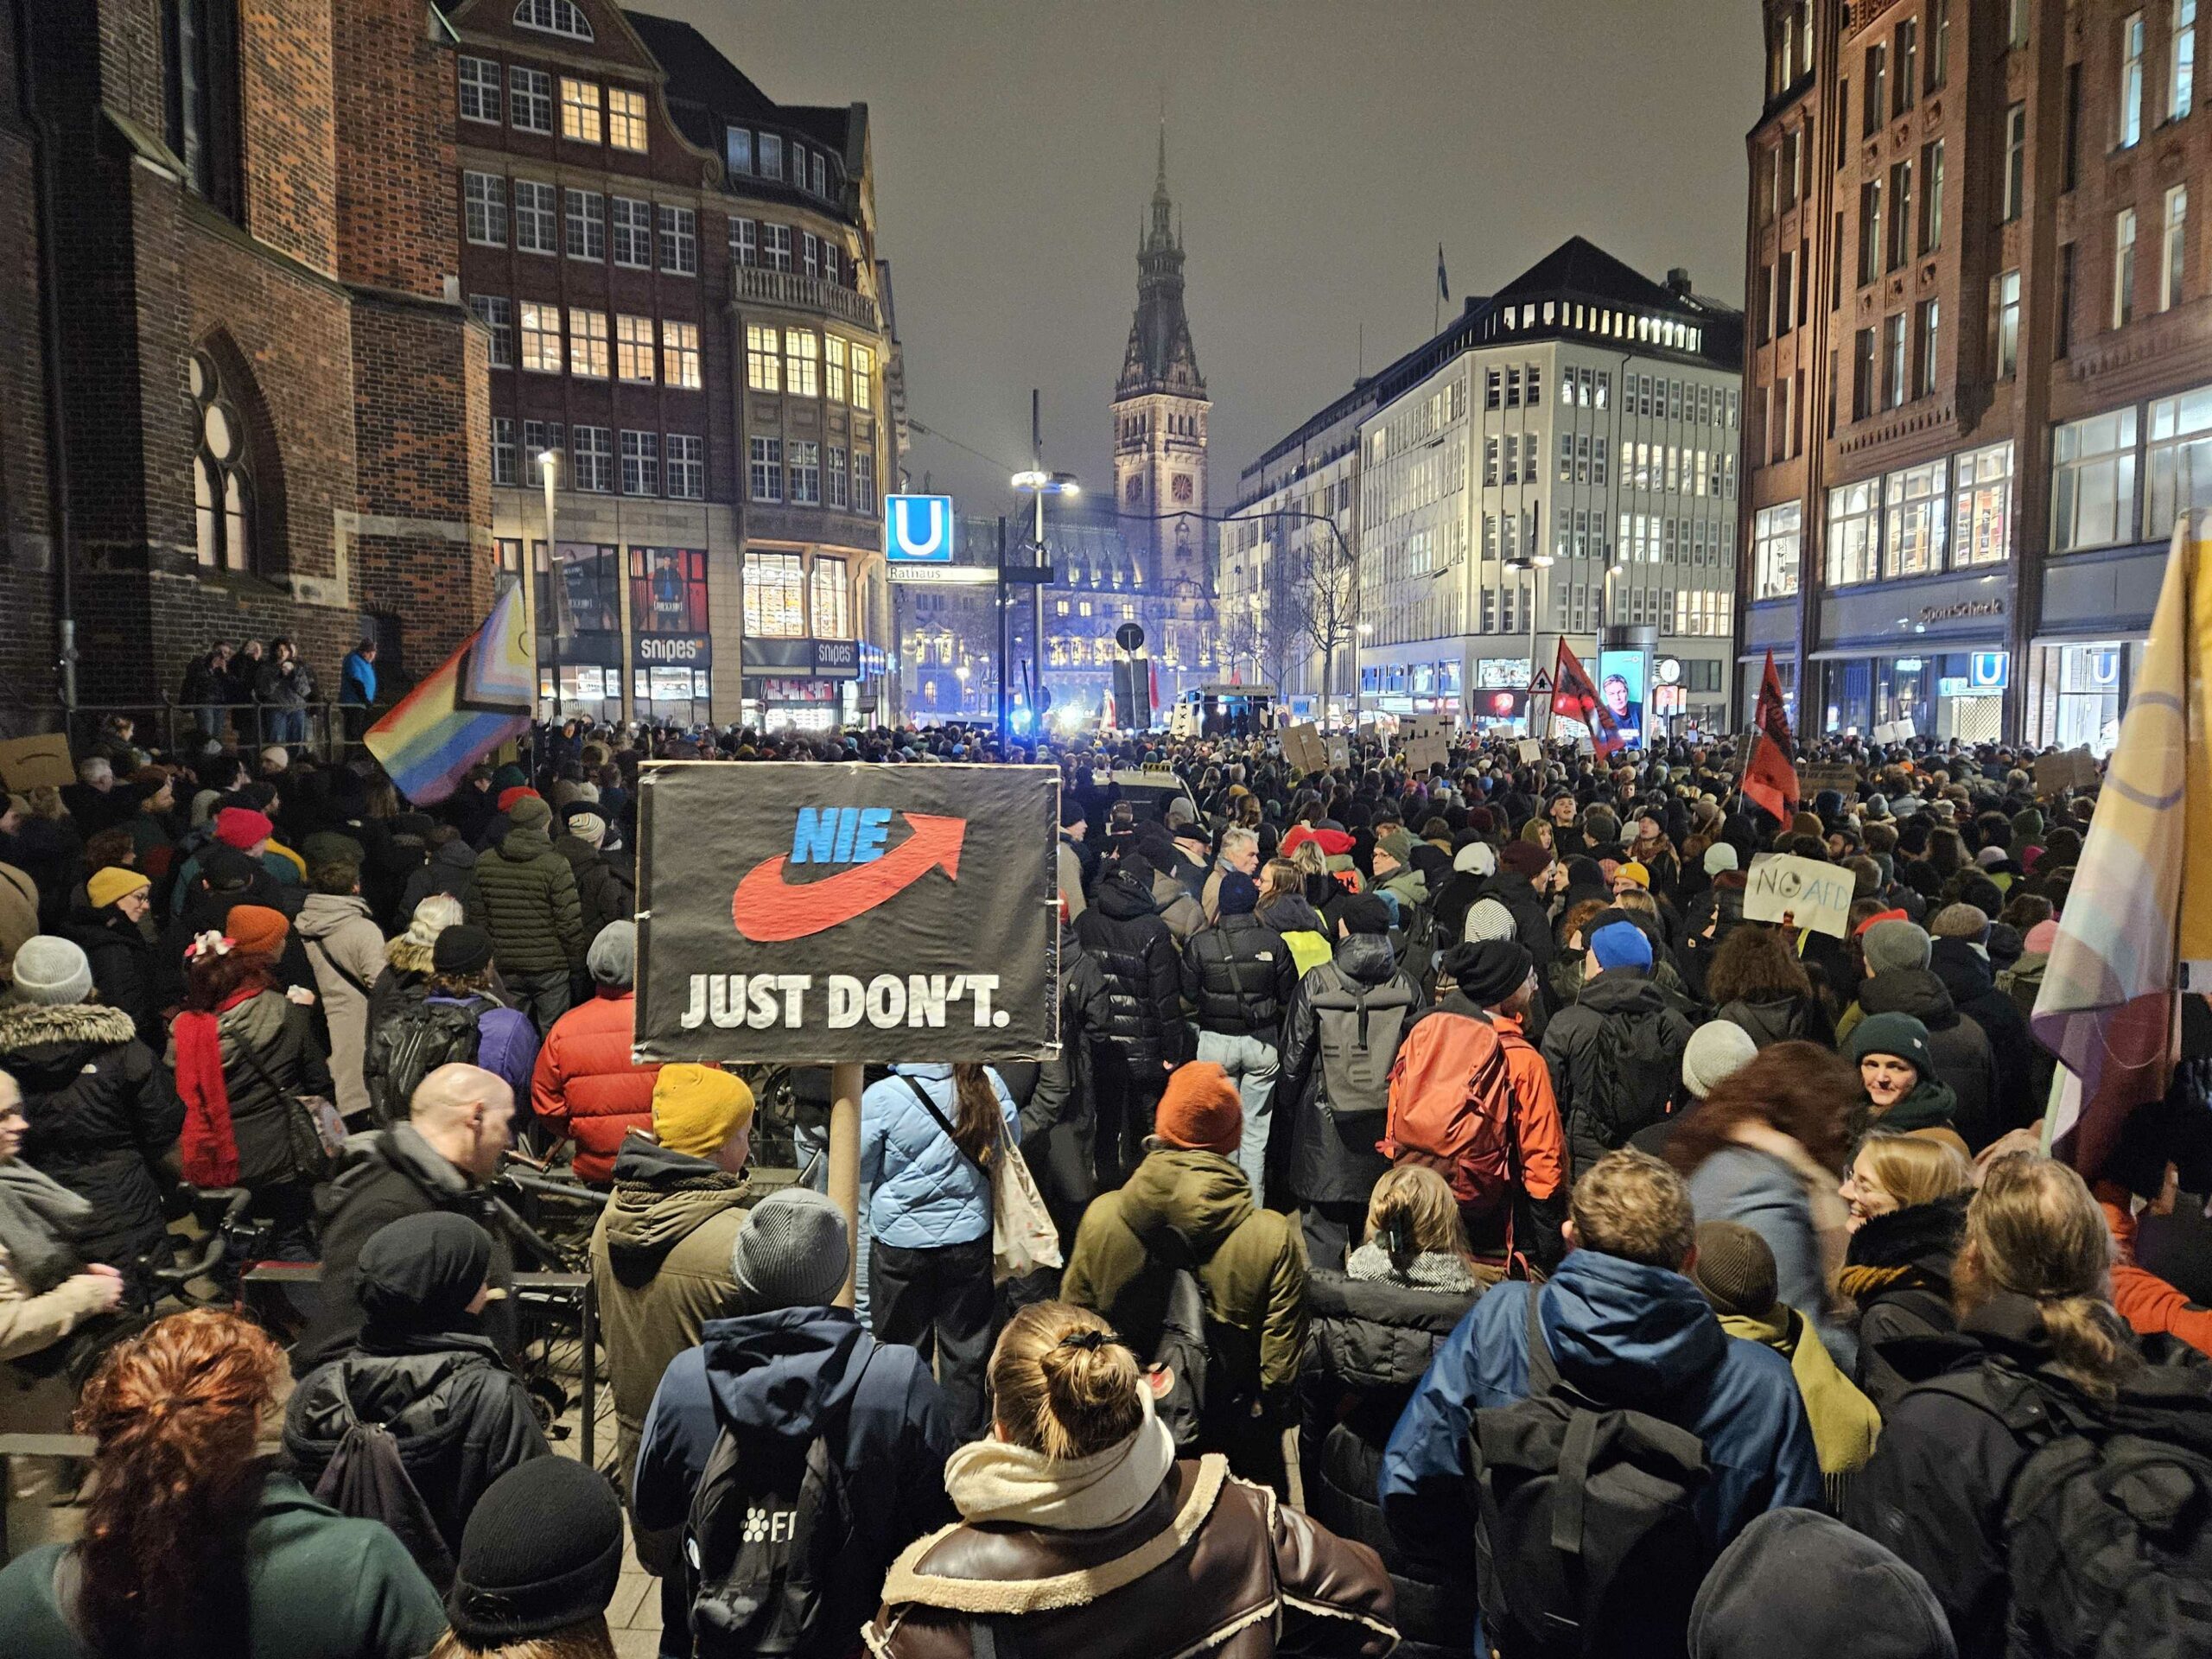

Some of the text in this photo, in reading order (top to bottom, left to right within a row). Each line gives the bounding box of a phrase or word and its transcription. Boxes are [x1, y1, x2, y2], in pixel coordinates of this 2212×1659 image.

[895, 499, 943, 556] U
[890, 567, 941, 579] Rathaus
[641, 639, 696, 663] snipes
[818, 644, 851, 665] snipes
[1975, 655, 2004, 685] U
[791, 807, 893, 863] NIE
[1757, 868, 1802, 899] NO
[680, 974, 1011, 1029] JUST DON'T.
